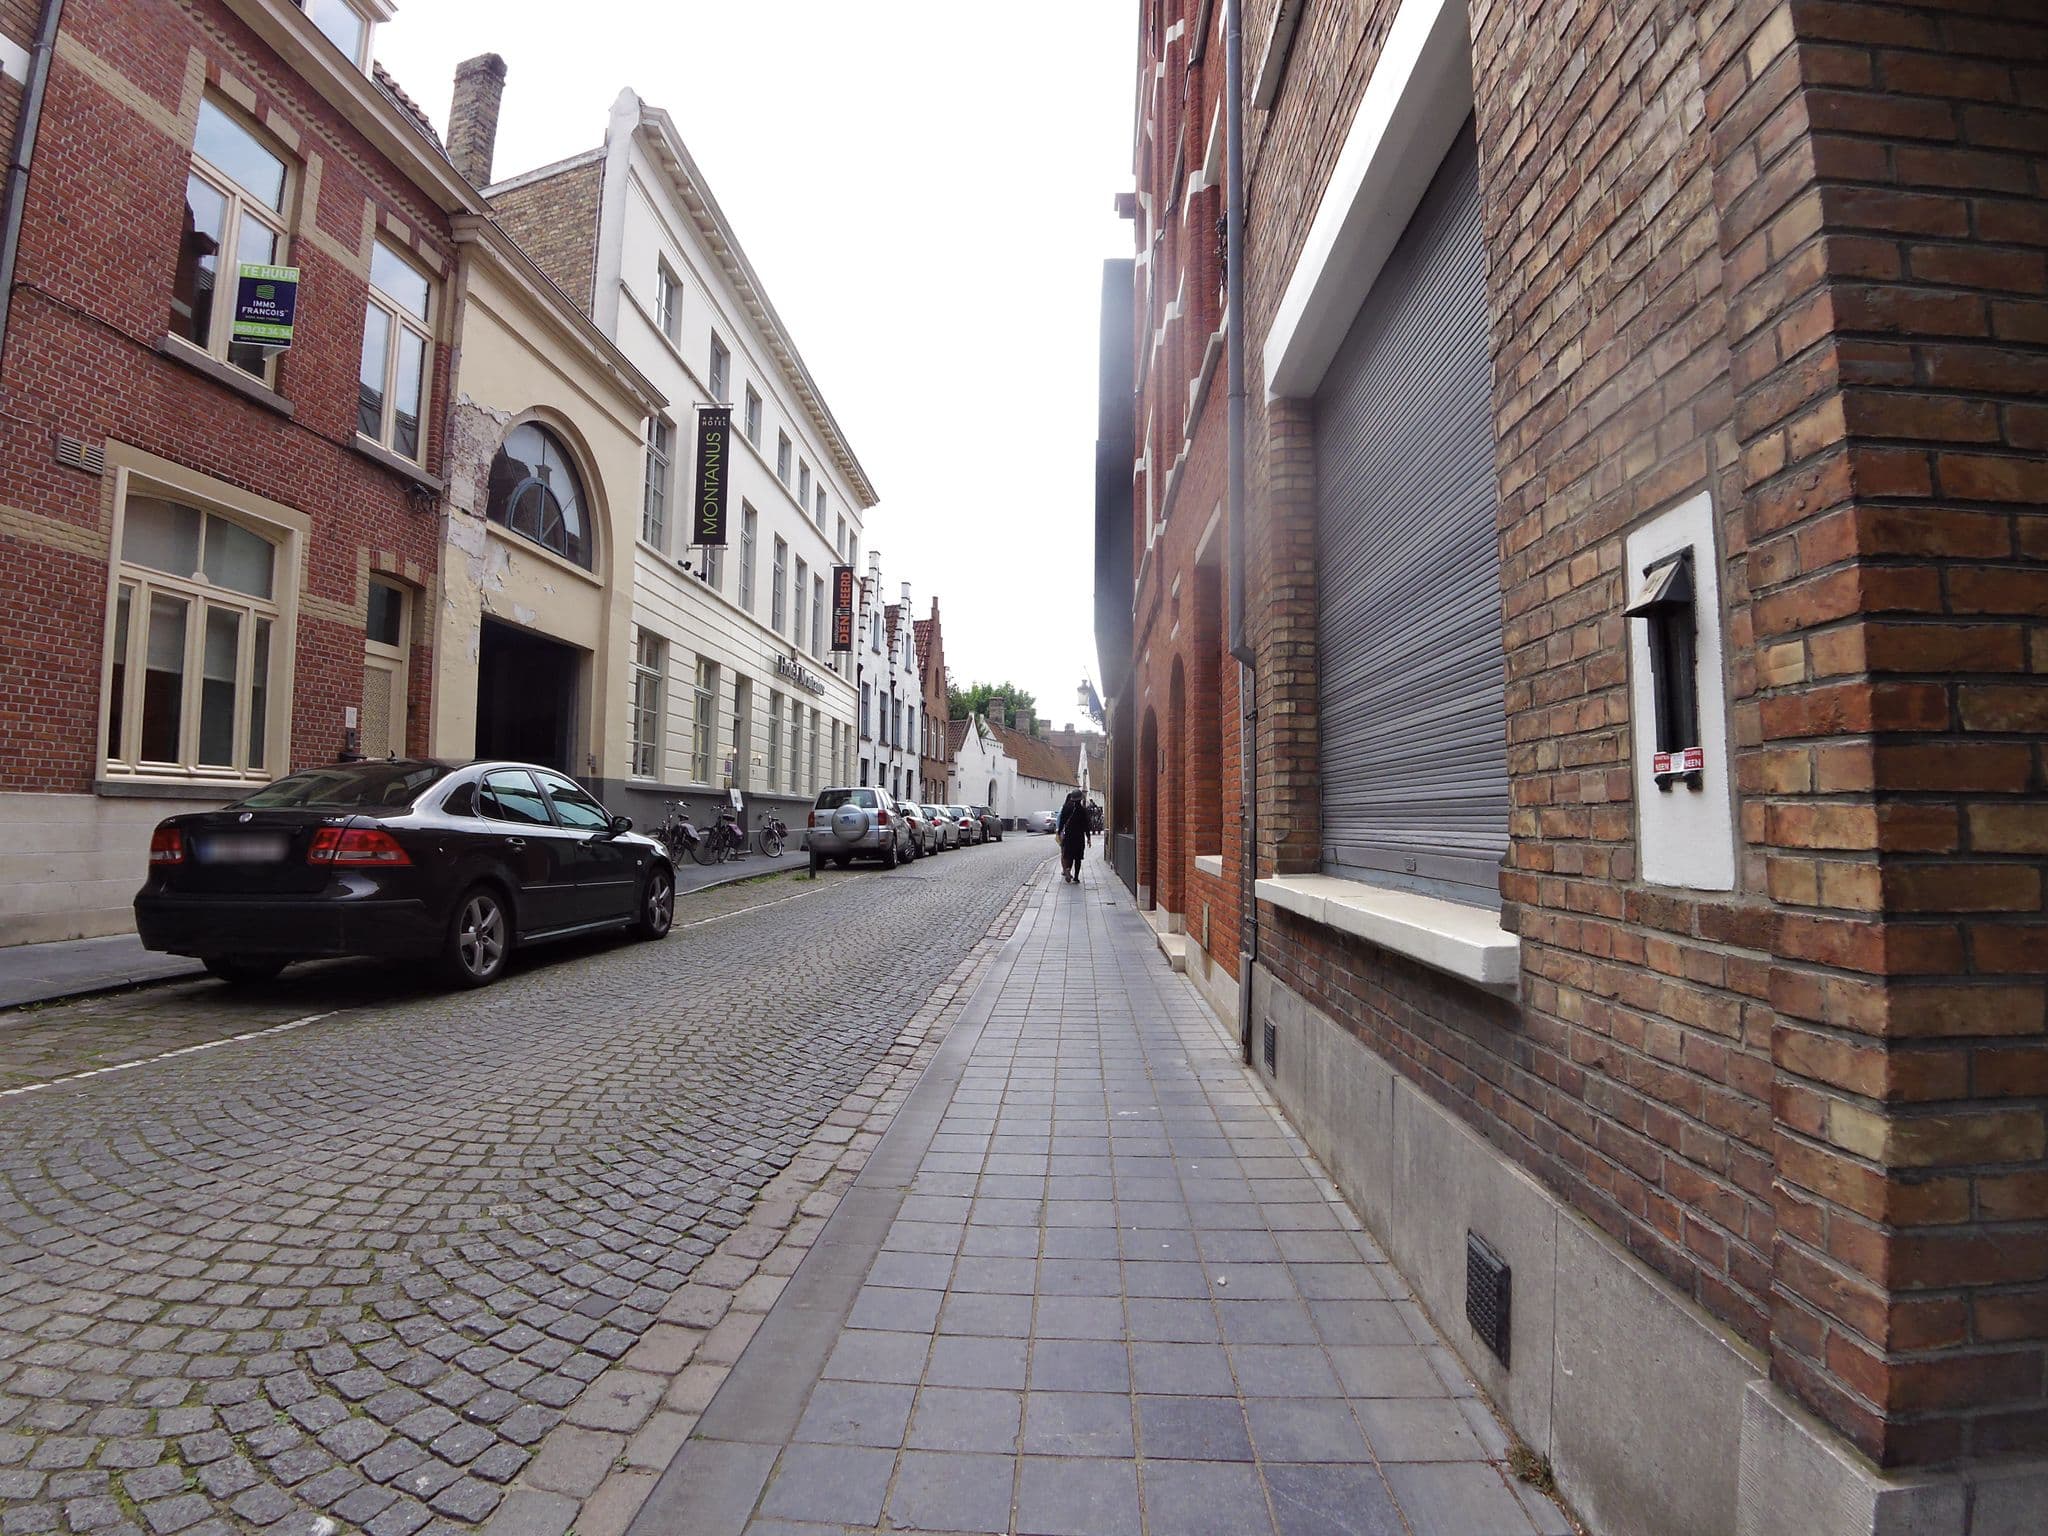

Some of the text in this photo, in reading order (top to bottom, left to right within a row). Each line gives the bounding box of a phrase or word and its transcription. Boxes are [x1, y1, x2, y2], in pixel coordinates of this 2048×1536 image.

[242, 265, 297, 279] TE HUUR
[252, 300, 276, 309] IMMO
[702, 432, 721, 535] MONTANUS
[839, 571, 851, 644] DEN HEERD
